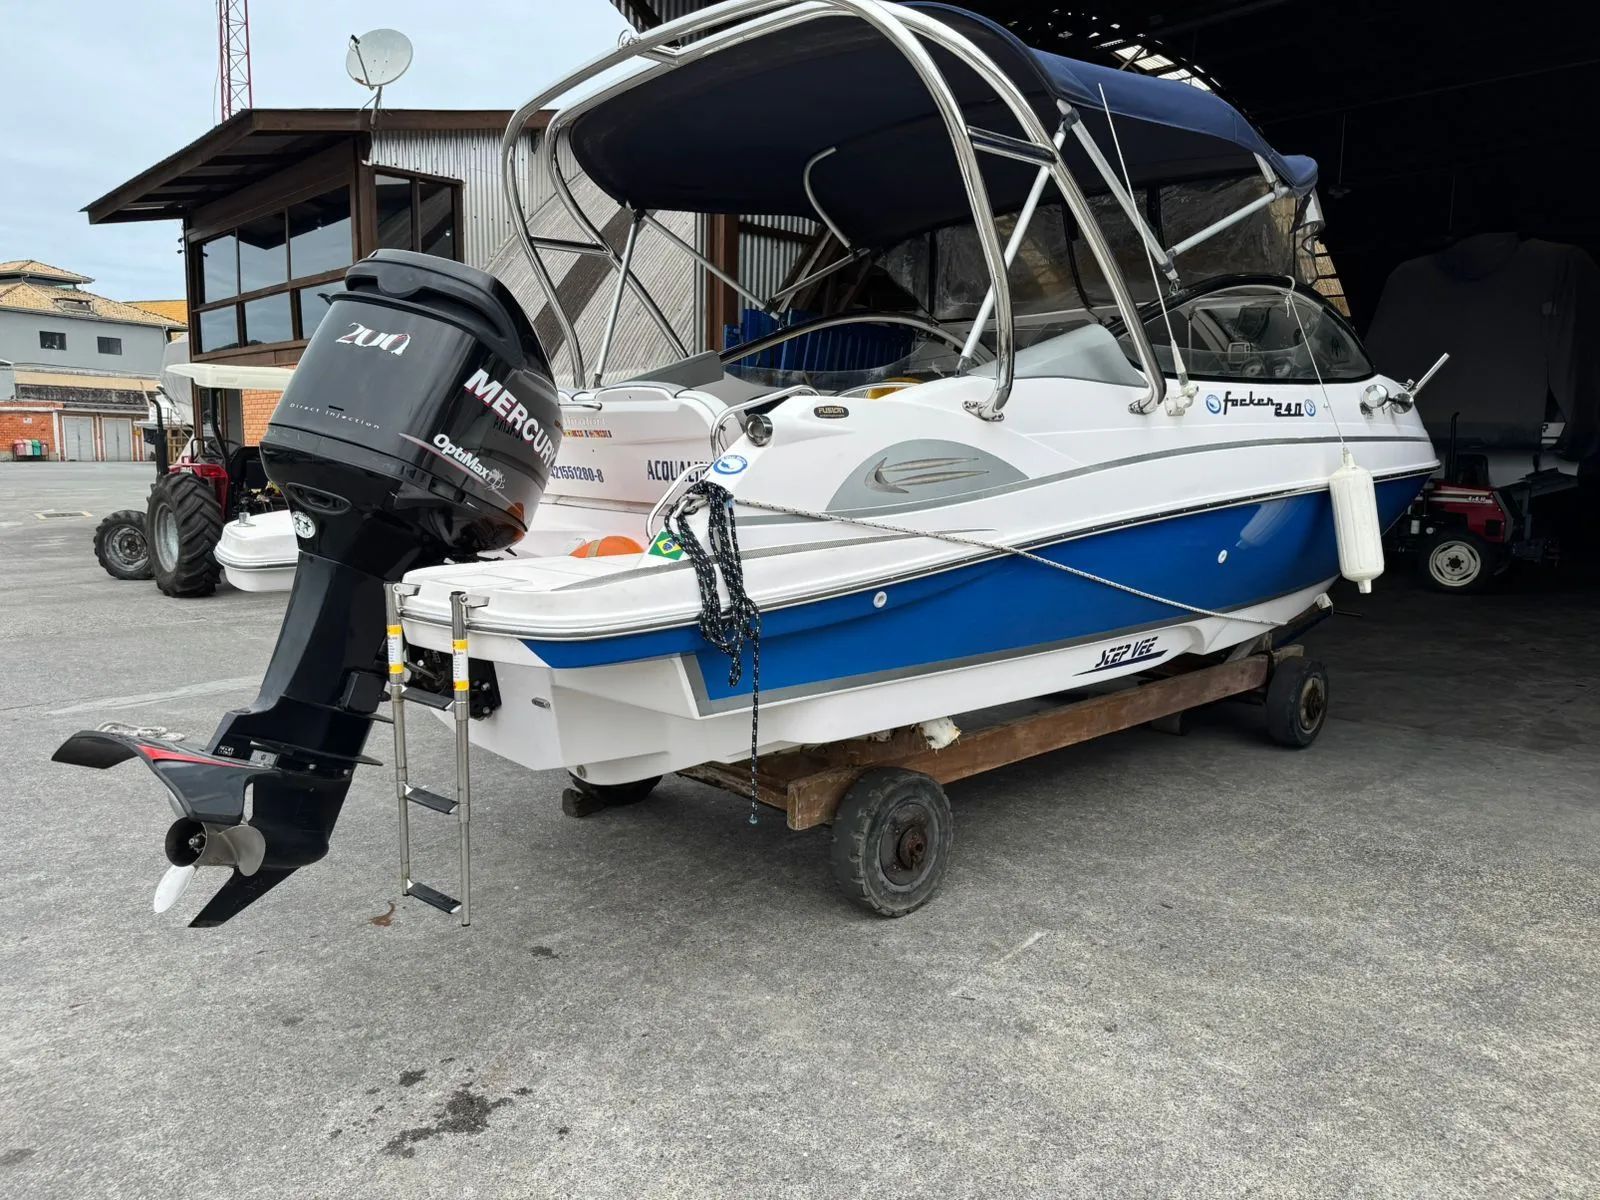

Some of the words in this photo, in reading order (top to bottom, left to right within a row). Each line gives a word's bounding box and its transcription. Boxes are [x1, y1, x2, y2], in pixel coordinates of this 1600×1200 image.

[335, 322, 411, 356] 200
[289, 402, 320, 413] Direct
[463, 367, 557, 469] MERCURY
[433, 433, 491, 479] OptiMax
[1131, 636, 1159, 658] VEE
